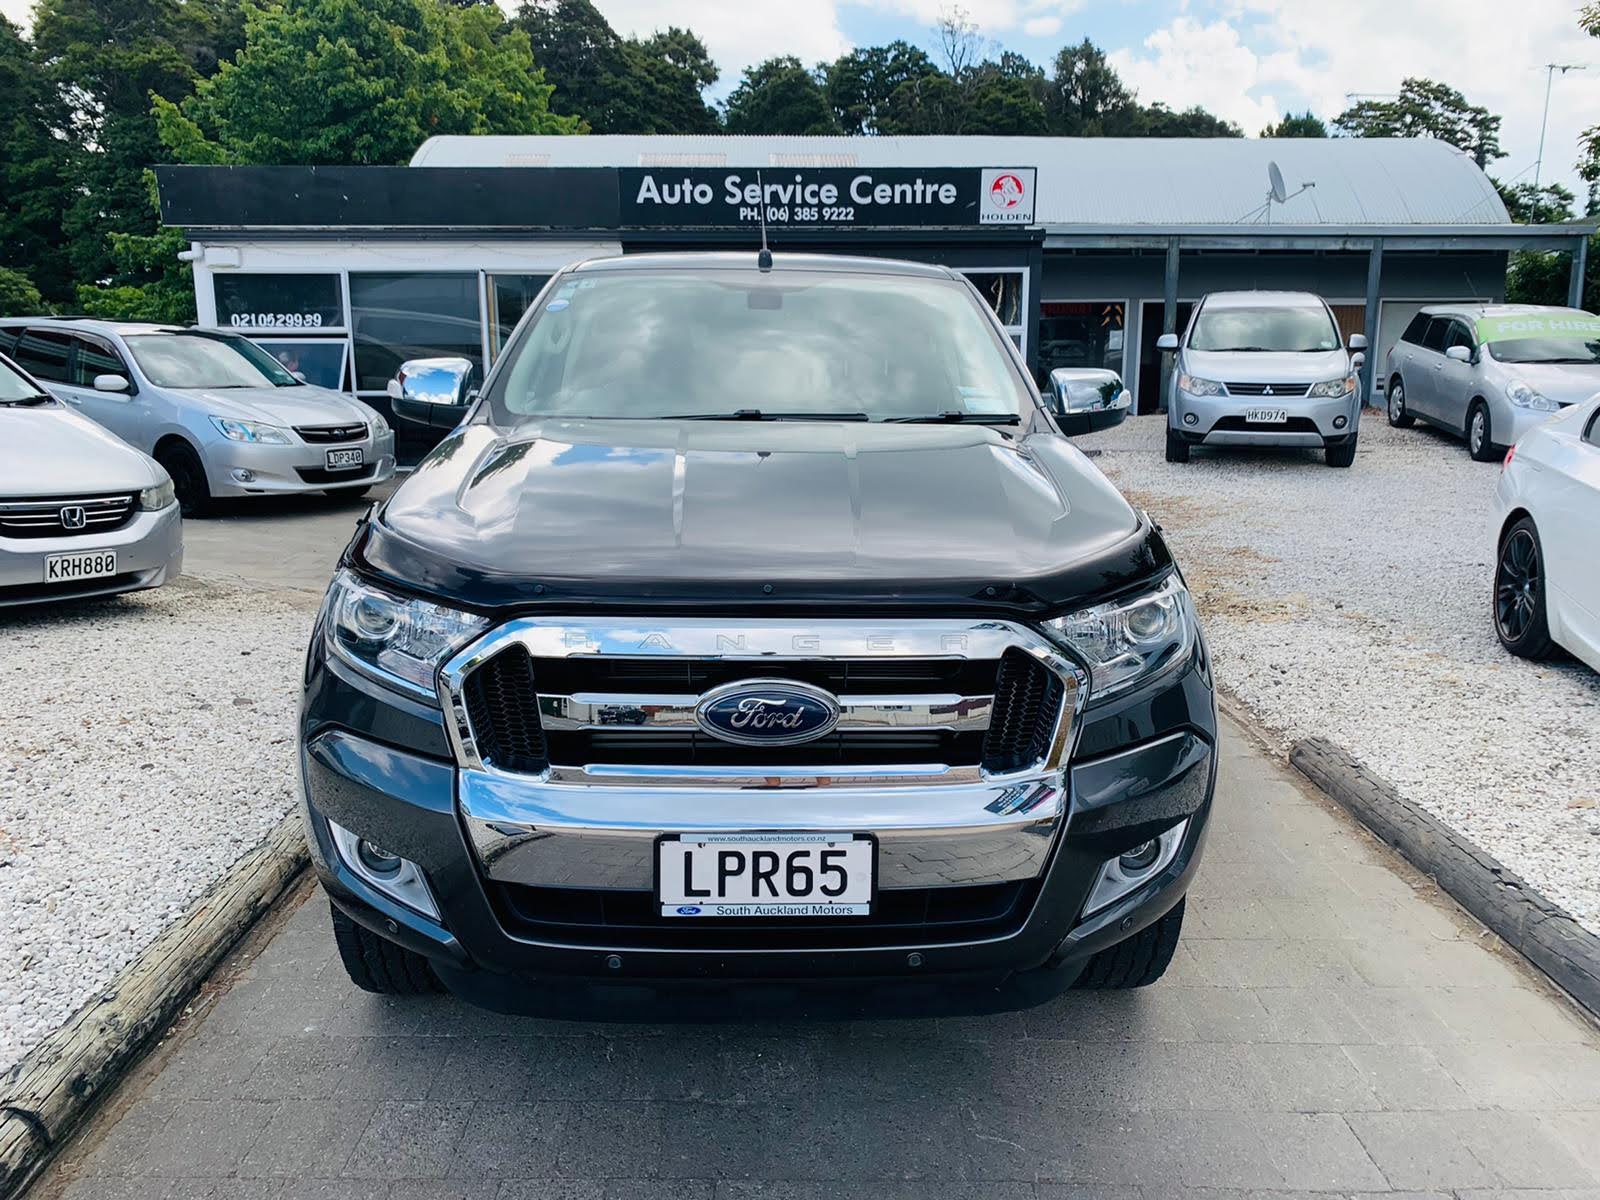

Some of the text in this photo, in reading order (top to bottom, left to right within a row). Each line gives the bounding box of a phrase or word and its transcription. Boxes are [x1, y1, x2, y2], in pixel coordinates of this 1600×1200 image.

[636, 174, 958, 205] Auto Service Centre
[766, 206, 789, 222] (06)
[794, 207, 818, 221] 385
[822, 207, 855, 221] 9222
[981, 213, 1031, 221] HOLDEN
[1497, 320, 1545, 333] FOR
[1247, 410, 1286, 421] HKD974
[49, 554, 115, 579] KRH880
[564, 632, 968, 651] RANGER
[730, 697, 806, 729] Ford
[707, 834, 827, 843] www.southaucklandmotors.co.nz
[683, 849, 848, 898] LPR65
[716, 906, 751, 916] South
[754, 905, 809, 916] Auckland
[812, 905, 854, 916] Motors
